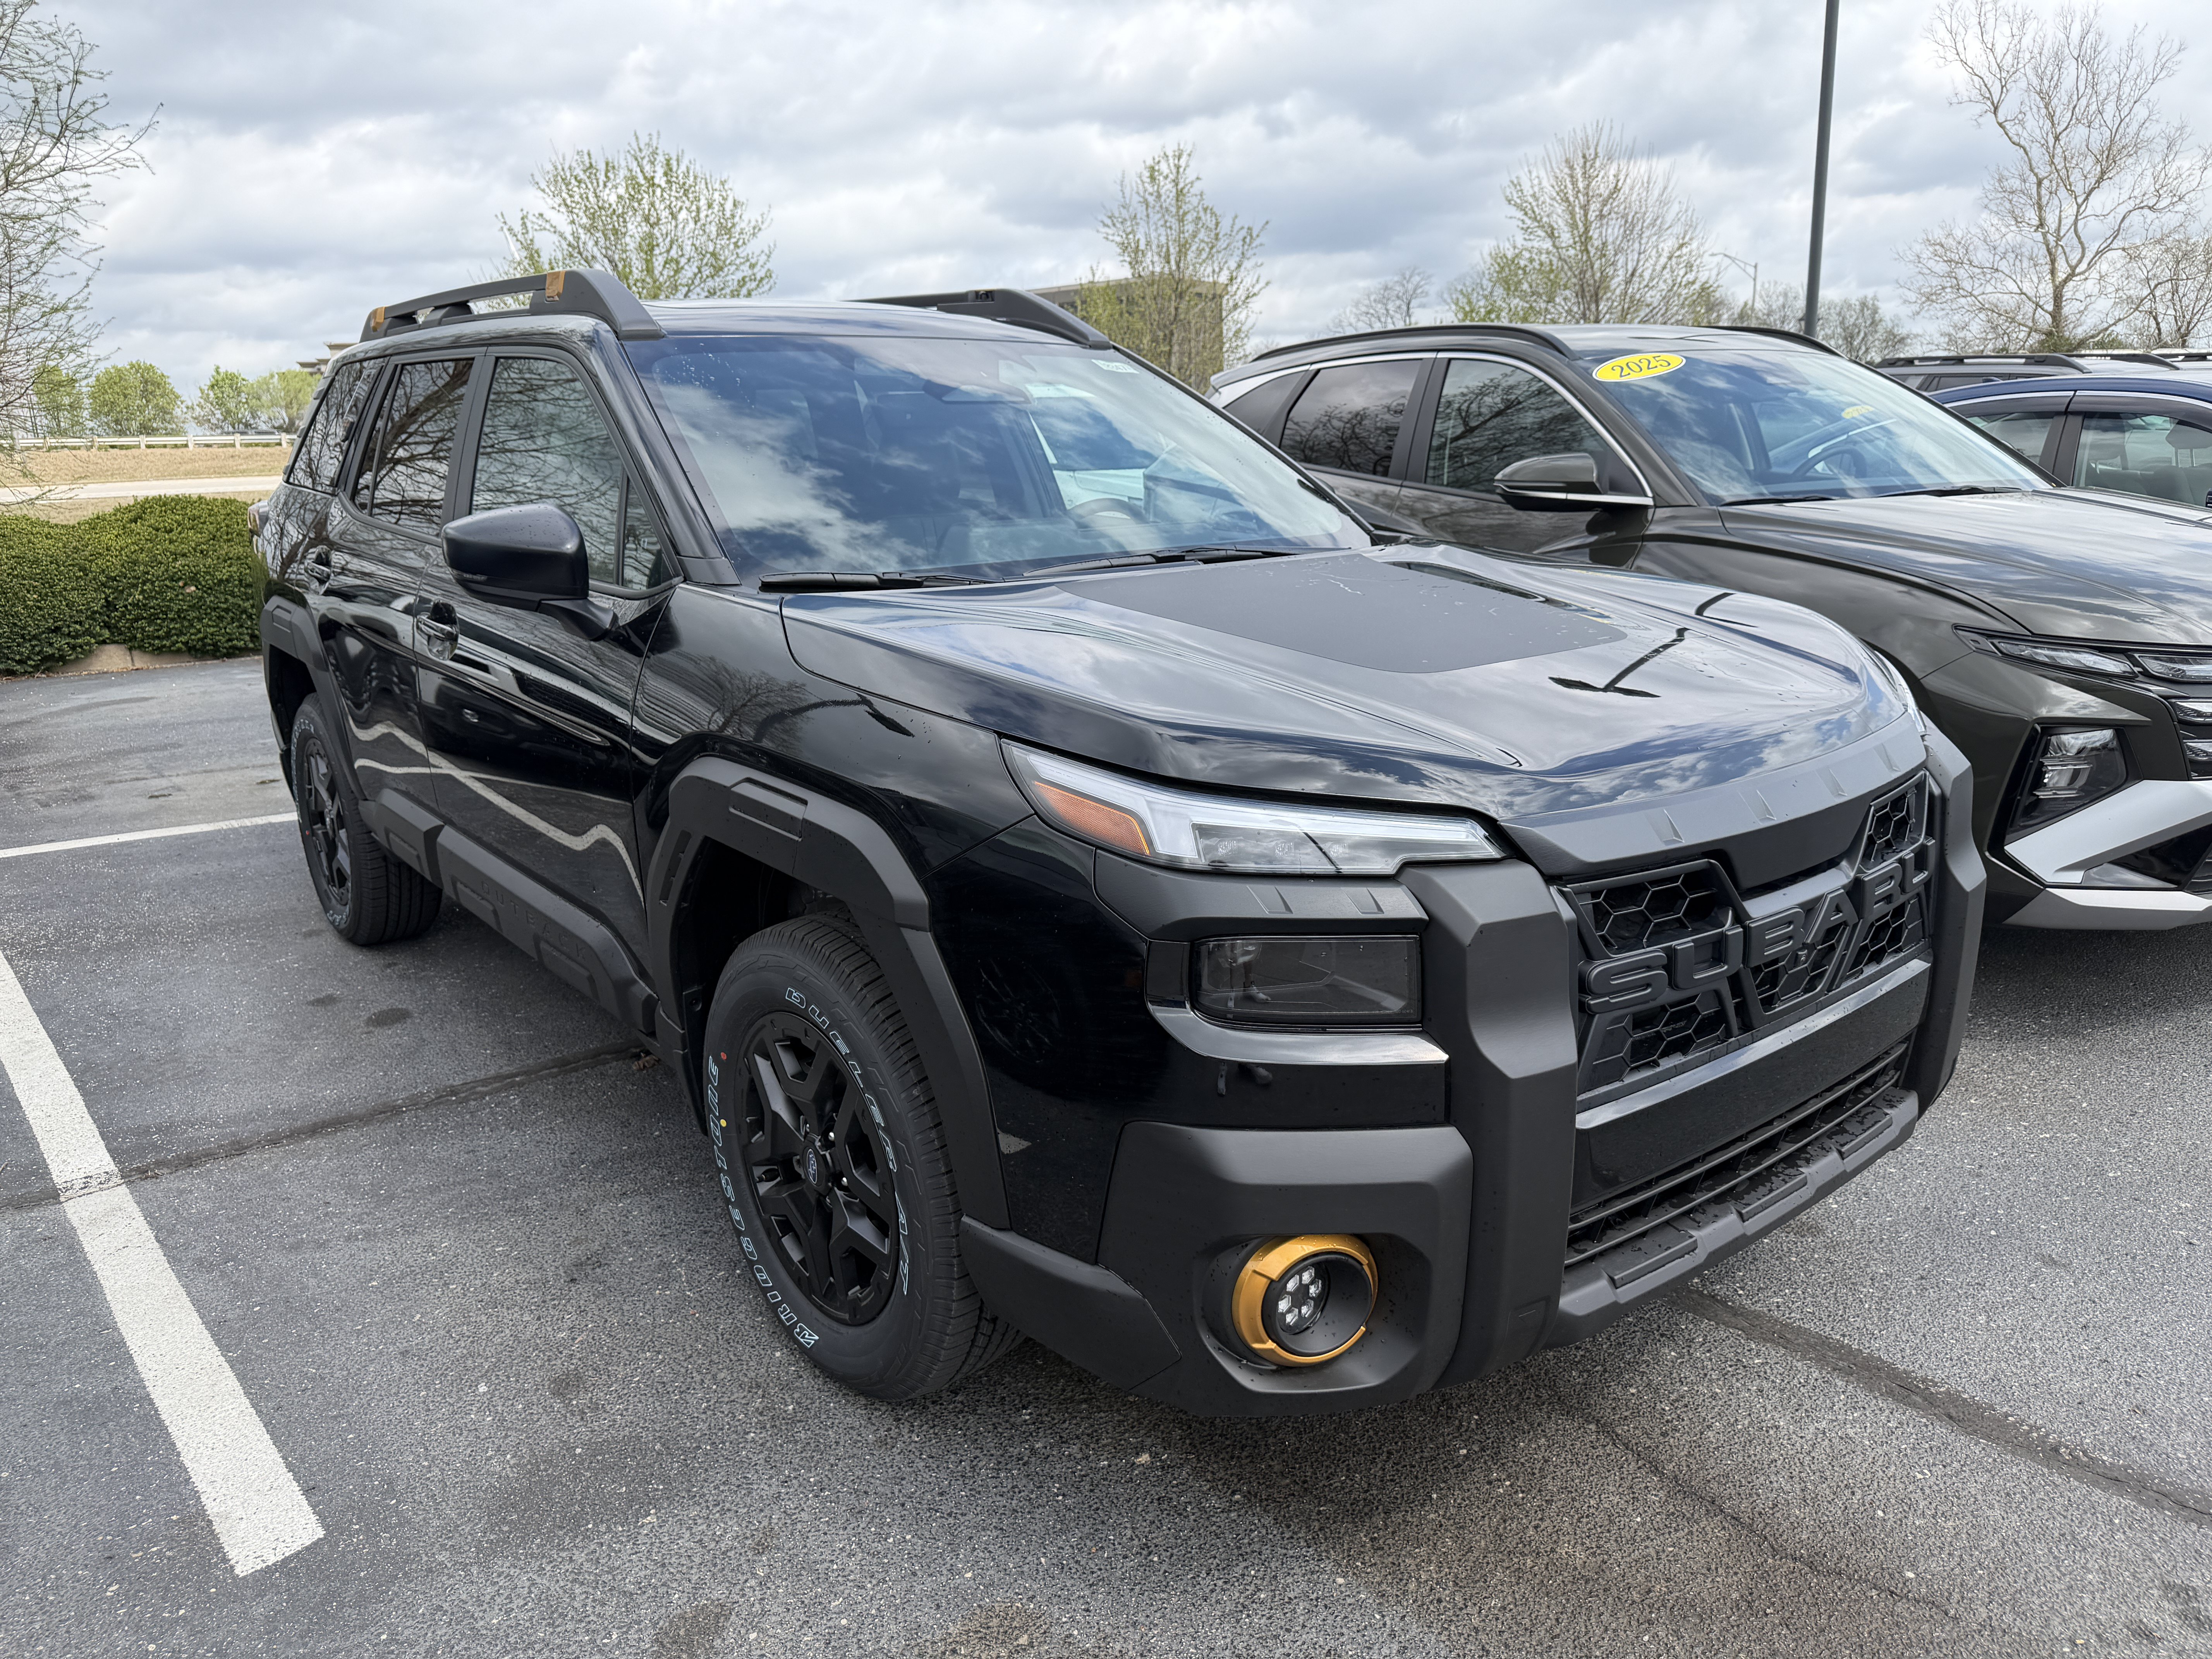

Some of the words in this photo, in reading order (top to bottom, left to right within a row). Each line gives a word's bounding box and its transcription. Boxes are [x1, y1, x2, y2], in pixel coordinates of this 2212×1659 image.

[1611, 355, 1671, 378] 2025
[481, 881, 586, 961] OUTBACK
[1586, 837, 1936, 1014] SUBARU
[708, 1055, 819, 1348] BRIDGESTONE
[785, 987, 897, 1172] DUELER
[895, 1190, 909, 1296] A/T
